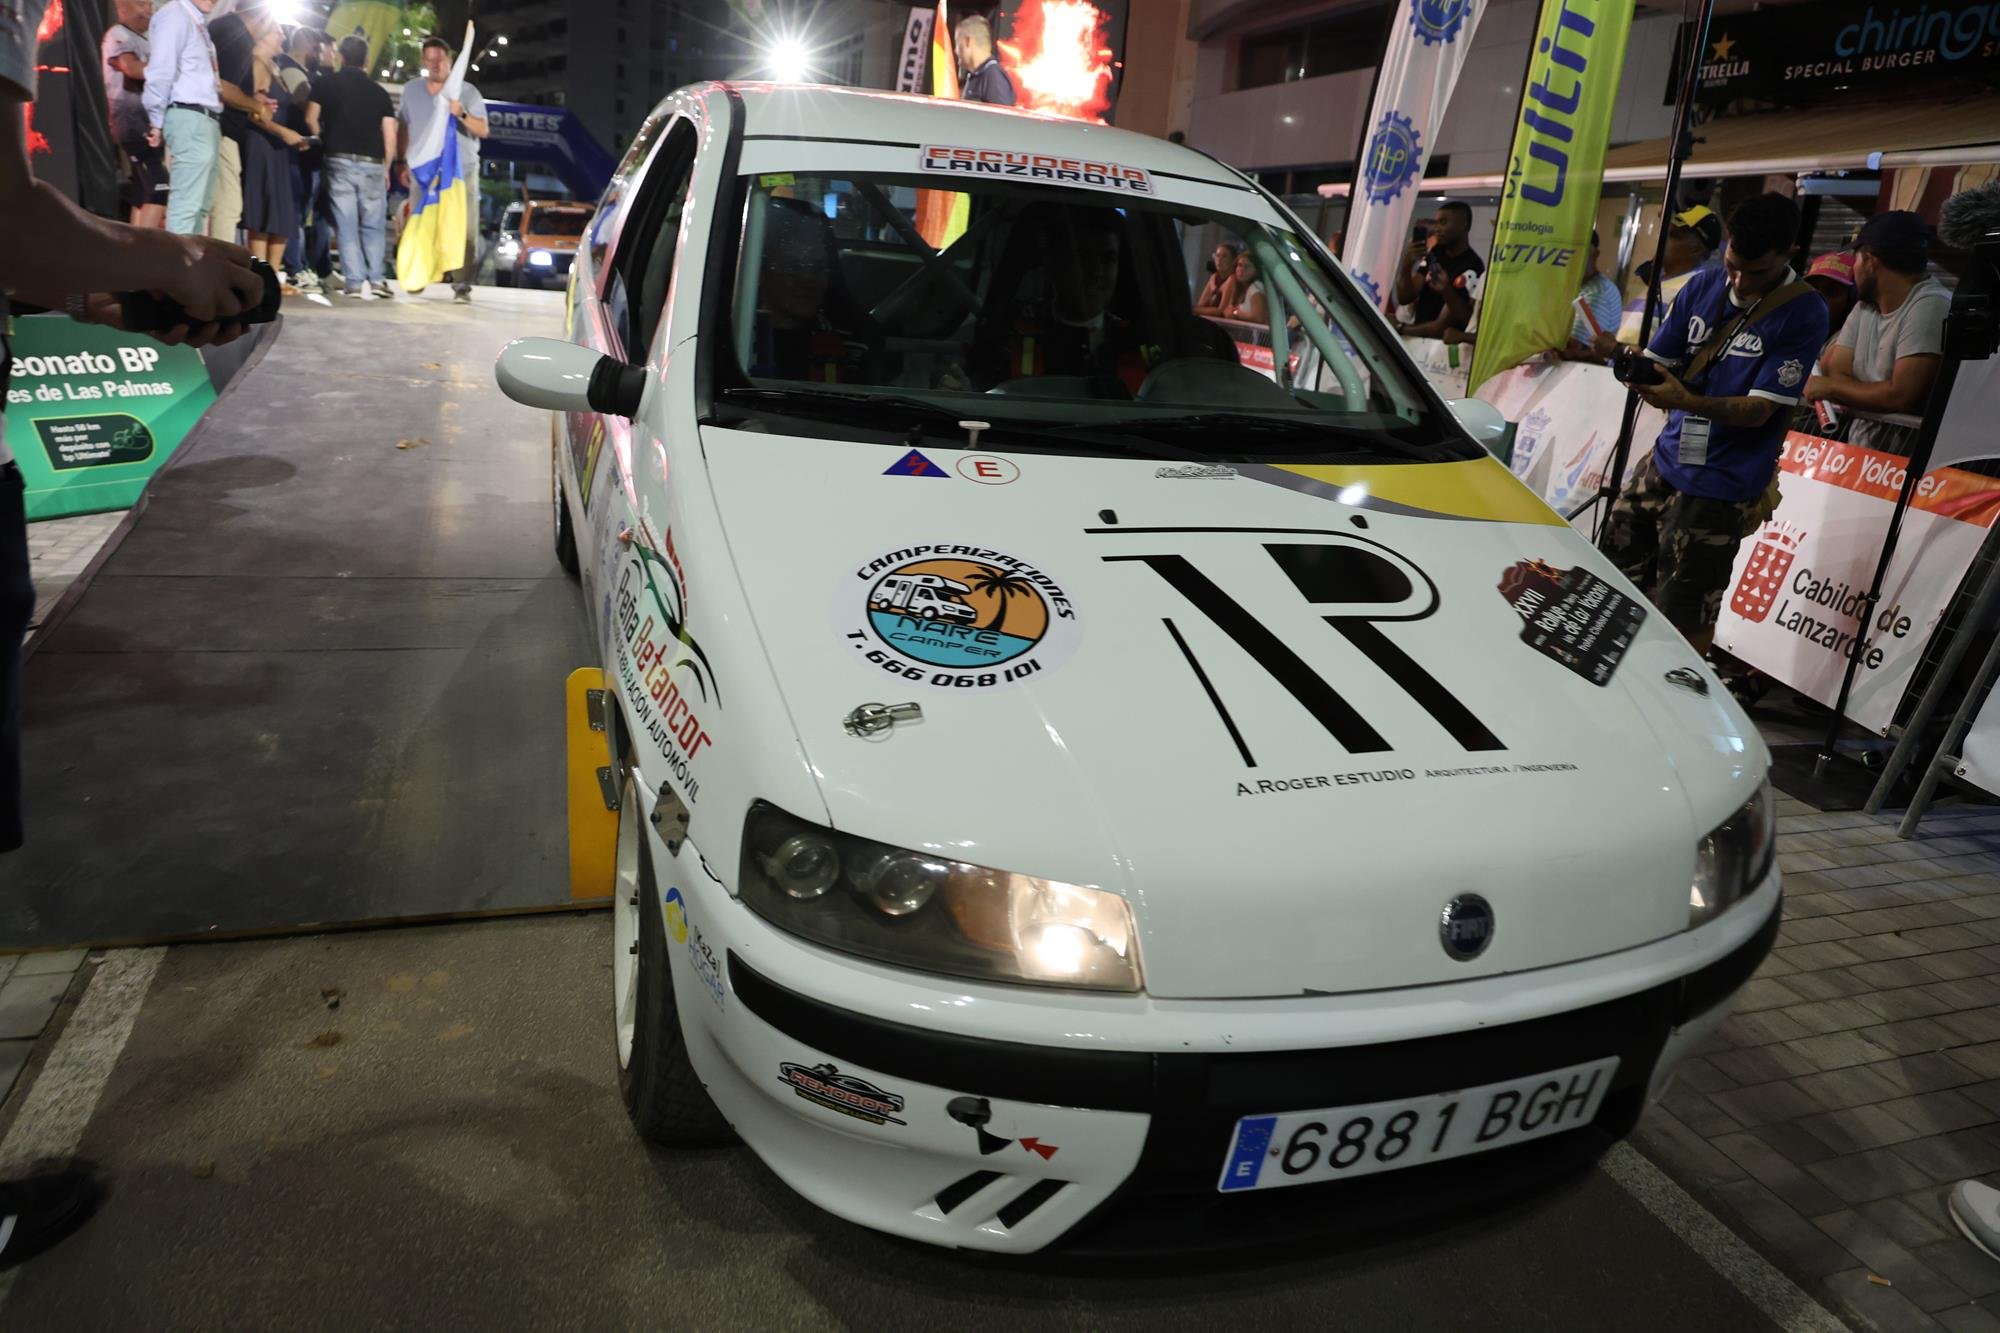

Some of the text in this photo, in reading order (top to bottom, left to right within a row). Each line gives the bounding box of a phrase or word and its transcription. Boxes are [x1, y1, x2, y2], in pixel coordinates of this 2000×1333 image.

[1834, 2, 2000, 60] chiring
[1784, 50, 1936, 80] SPECIAL BURGER
[925, 158, 1149, 192] LANZAROTE
[927, 147, 1146, 181] ESCUDERÍA
[117, 346, 159, 373] BP
[35, 383, 64, 402] de
[63, 382, 103, 400] Las
[102, 379, 174, 397] Palmas
[974, 461, 1003, 478] E
[1793, 440, 1821, 467] de
[1820, 446, 1855, 475] Los
[856, 544, 1076, 620] CAMPERIZACIONES
[1513, 587, 1547, 619] XXVII
[1533, 605, 1568, 633] Rallye
[896, 615, 1001, 646] NARE
[1876, 604, 1913, 639] de
[888, 632, 1002, 658] CAMPER
[865, 649, 927, 681] 666
[930, 673, 998, 688] 068
[631, 613, 712, 762] Betancor
[646, 717, 700, 804] AUTOMÓVIL
[1335, 767, 1416, 786] ESTUDIO
[1280, 1068, 1603, 1176] 6881 BGH
[1236, 1160, 1254, 1178] E
